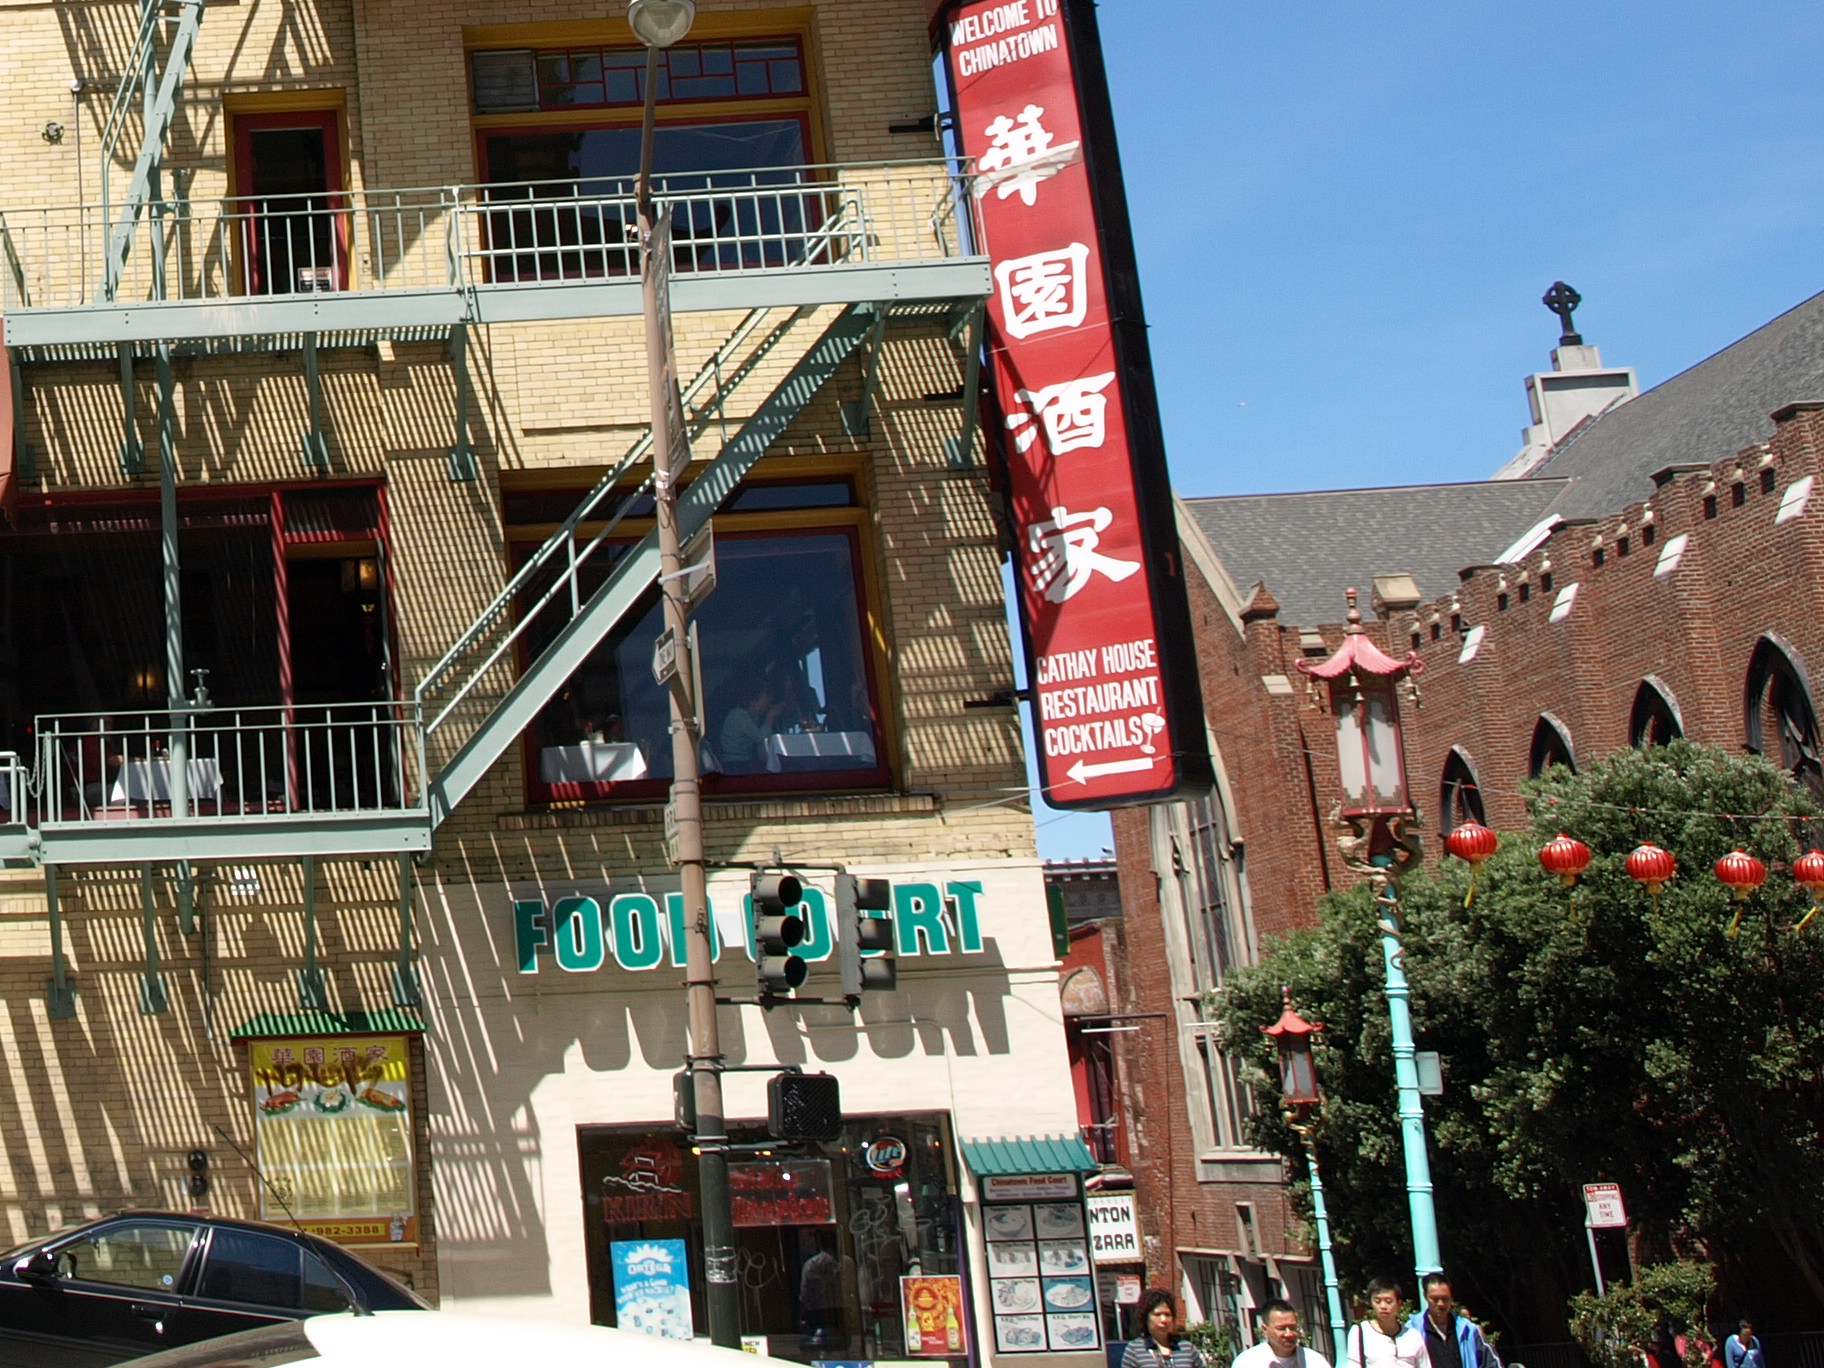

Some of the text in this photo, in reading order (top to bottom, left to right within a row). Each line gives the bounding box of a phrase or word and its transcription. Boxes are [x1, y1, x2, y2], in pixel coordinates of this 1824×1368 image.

[958, 23, 1058, 77] CHINATOWN
[1036, 638, 1158, 685] CATHAY HOUSE
[1040, 675, 1159, 721] RESTAURANT
[1044, 715, 1144, 757] COCKTAILS
[602, 1191, 694, 1224] KIRIN
[1089, 1205, 1131, 1224] NTON
